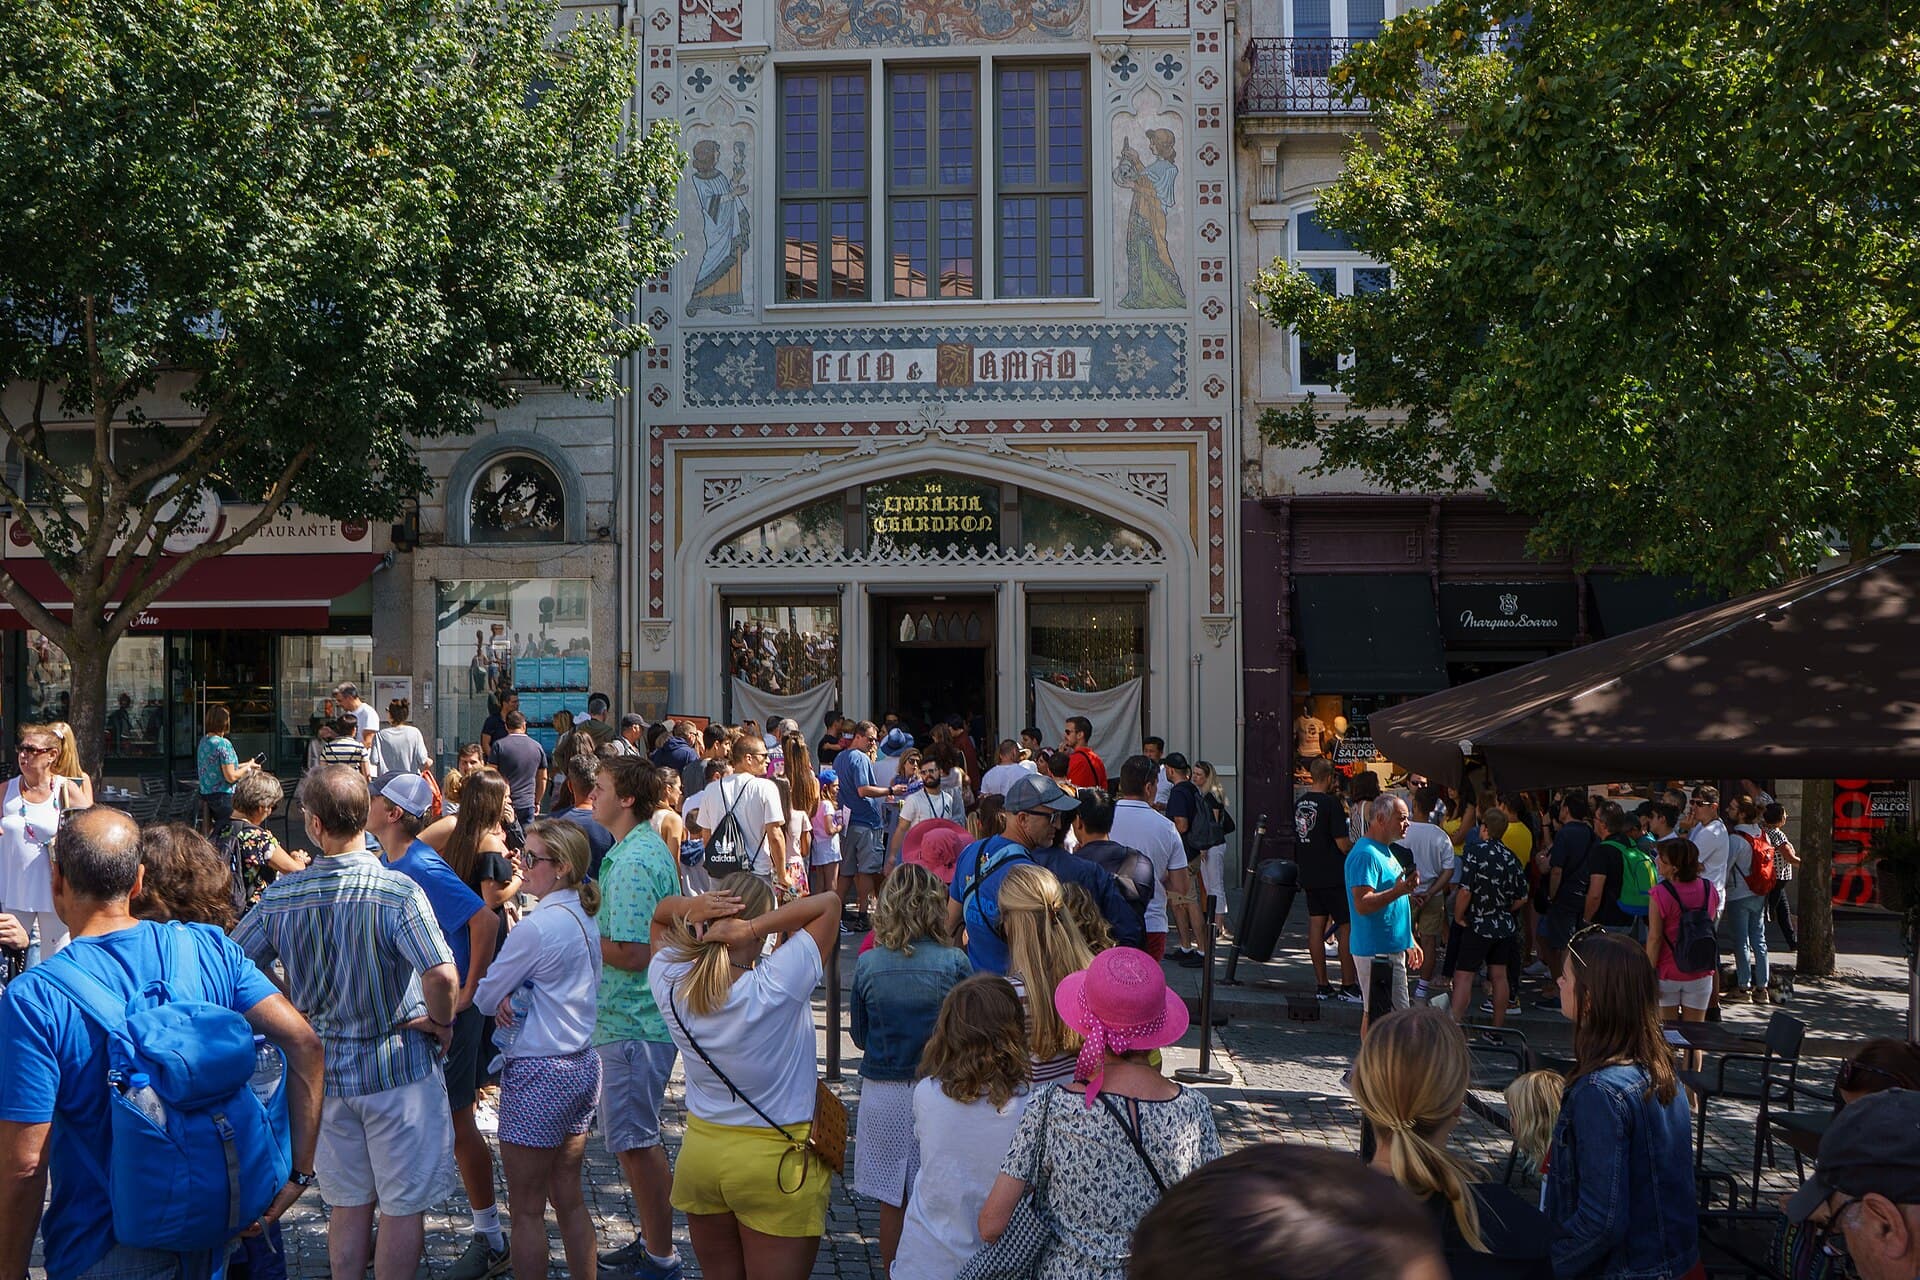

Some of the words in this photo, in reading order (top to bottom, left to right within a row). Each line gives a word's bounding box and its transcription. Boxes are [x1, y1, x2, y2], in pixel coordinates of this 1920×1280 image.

[779, 350, 895, 388] LELLO
[906, 361, 923, 381] &
[925, 484, 942, 493] 144
[884, 496, 983, 512] LIVRARIA
[231, 524, 336, 538] RTAURANTE
[873, 515, 993, 533] CHARDRON
[1460, 610, 1515, 630] Marques
[1515, 614, 1558, 627] Soares
[1338, 749, 1378, 758] SALDOS
[711, 854, 736, 863] adidas
